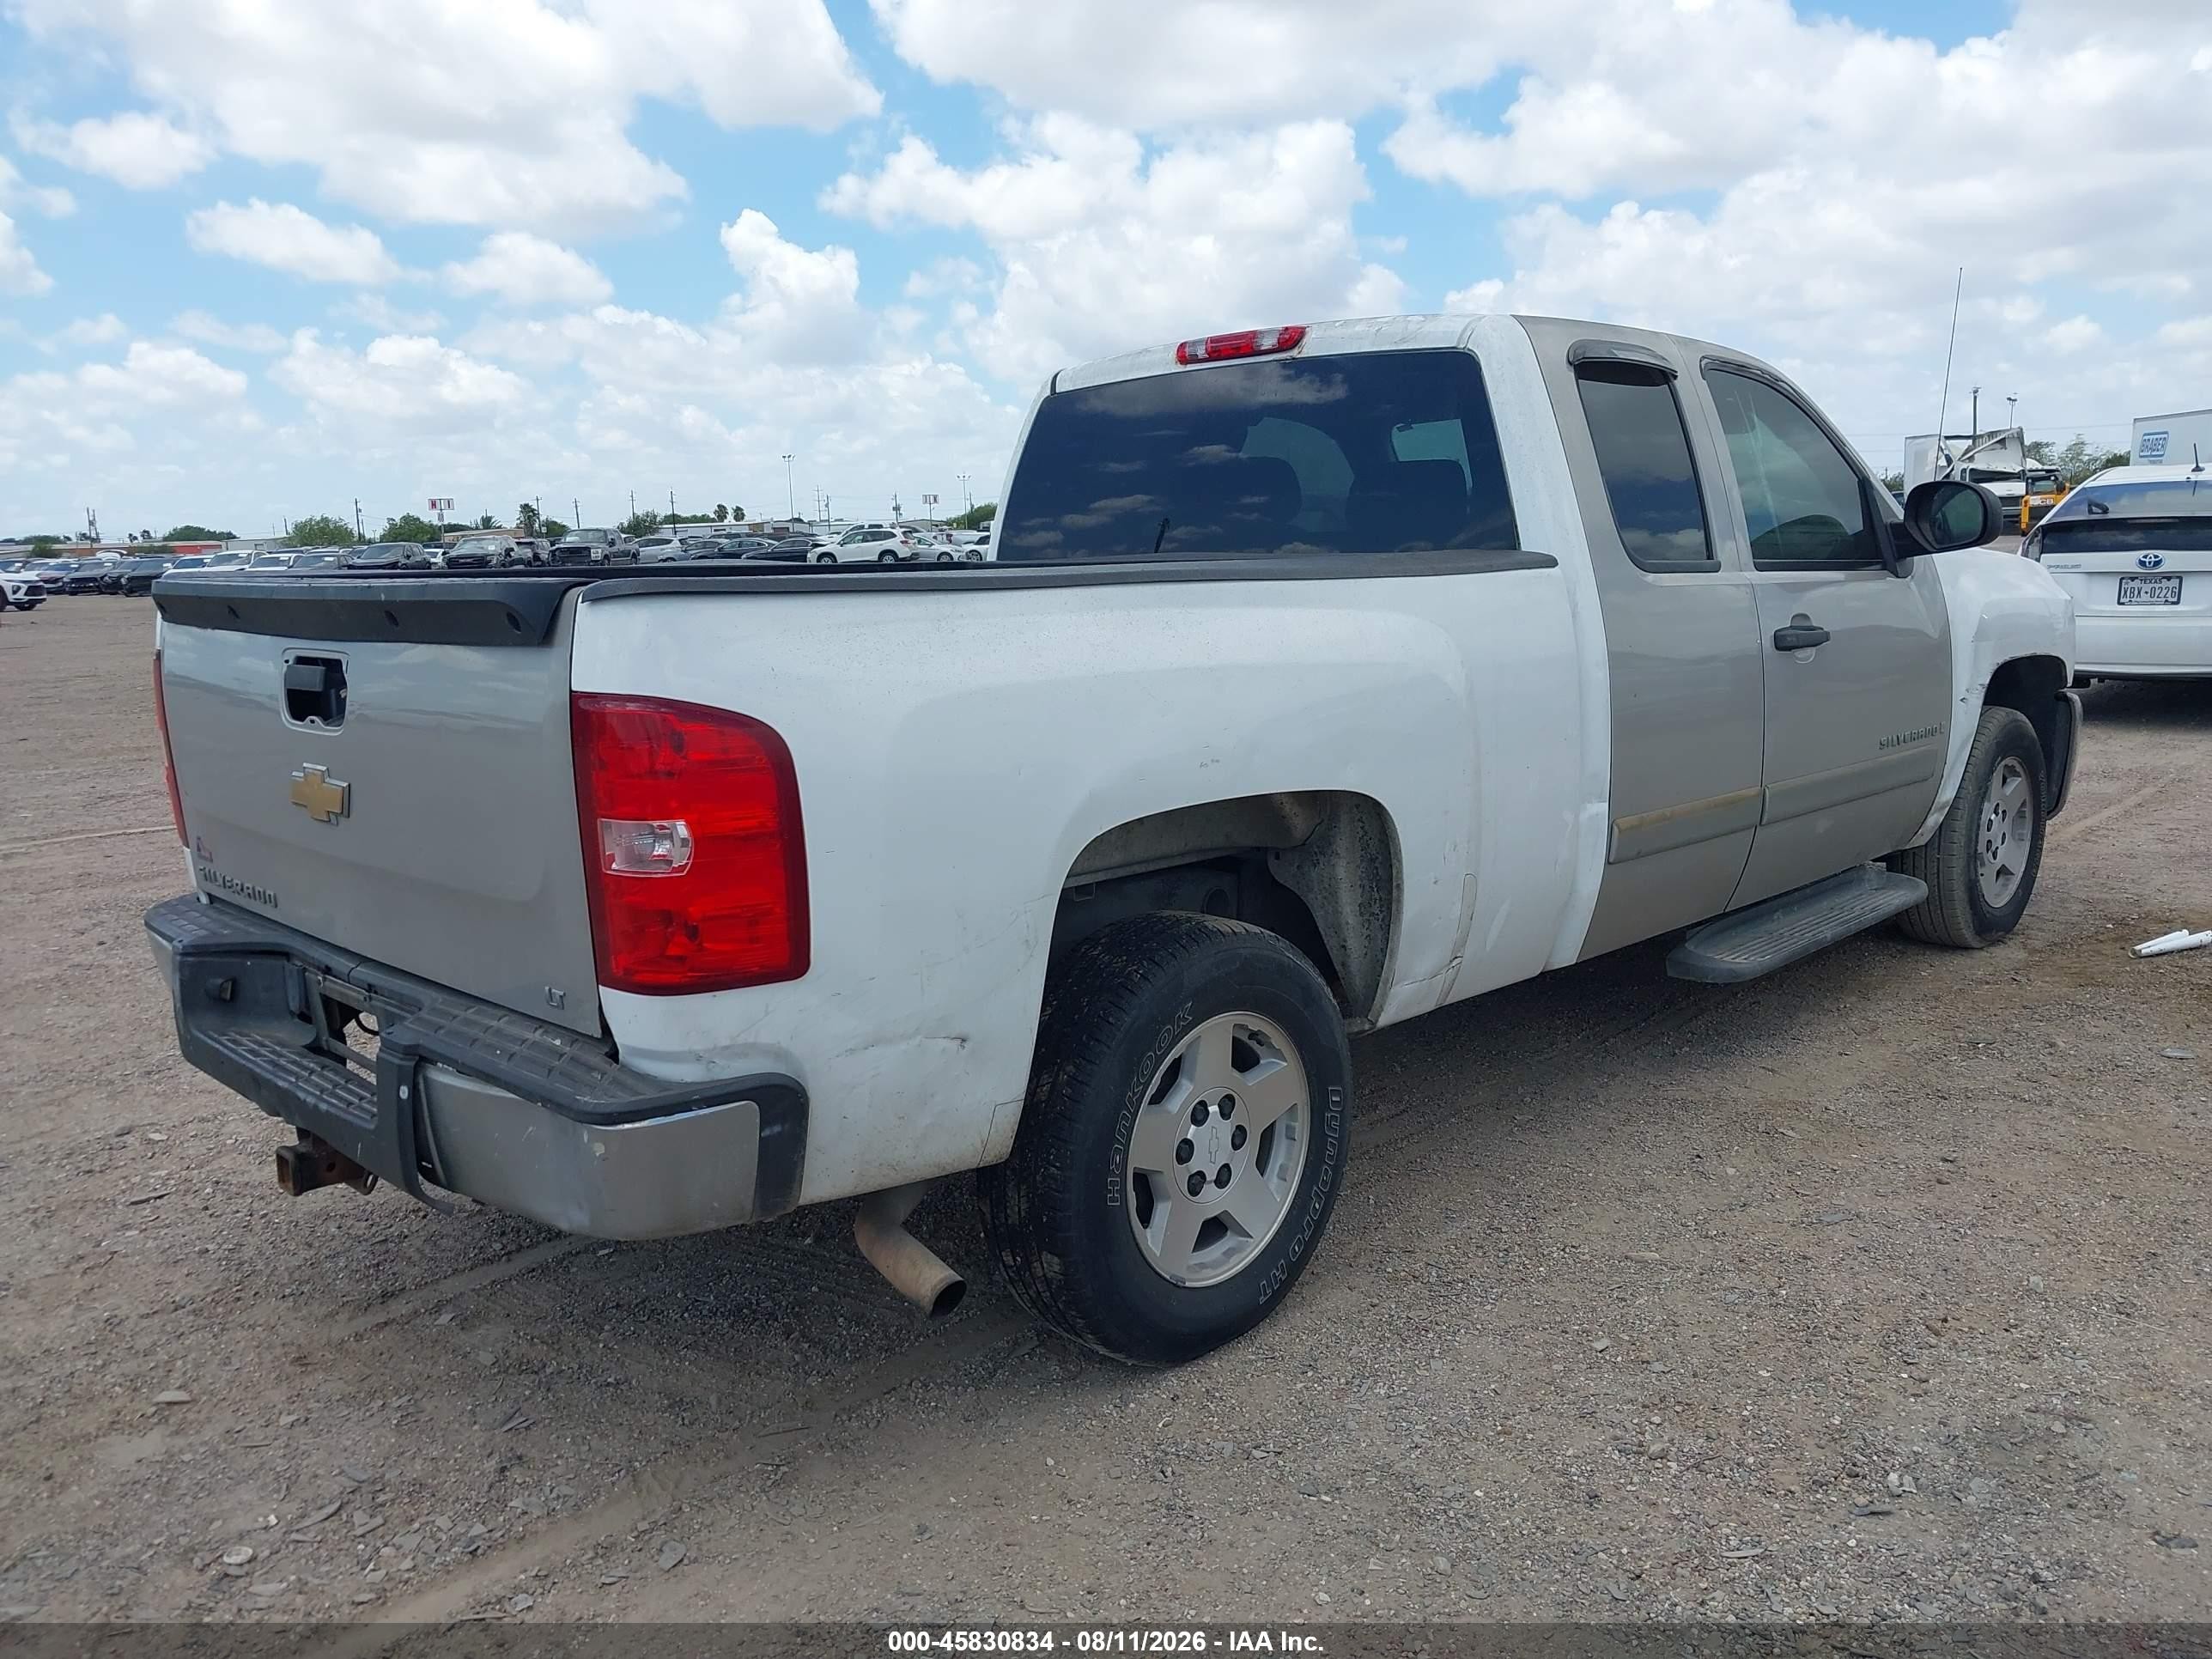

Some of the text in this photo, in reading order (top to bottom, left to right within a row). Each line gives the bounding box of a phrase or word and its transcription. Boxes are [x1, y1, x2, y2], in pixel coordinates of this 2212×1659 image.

[1878, 725, 1938, 750] SILVERADO
[198, 866, 278, 908] SILVERADO
[544, 986, 566, 1011] LT
[1259, 1086, 1344, 1305] Dynapro HT
